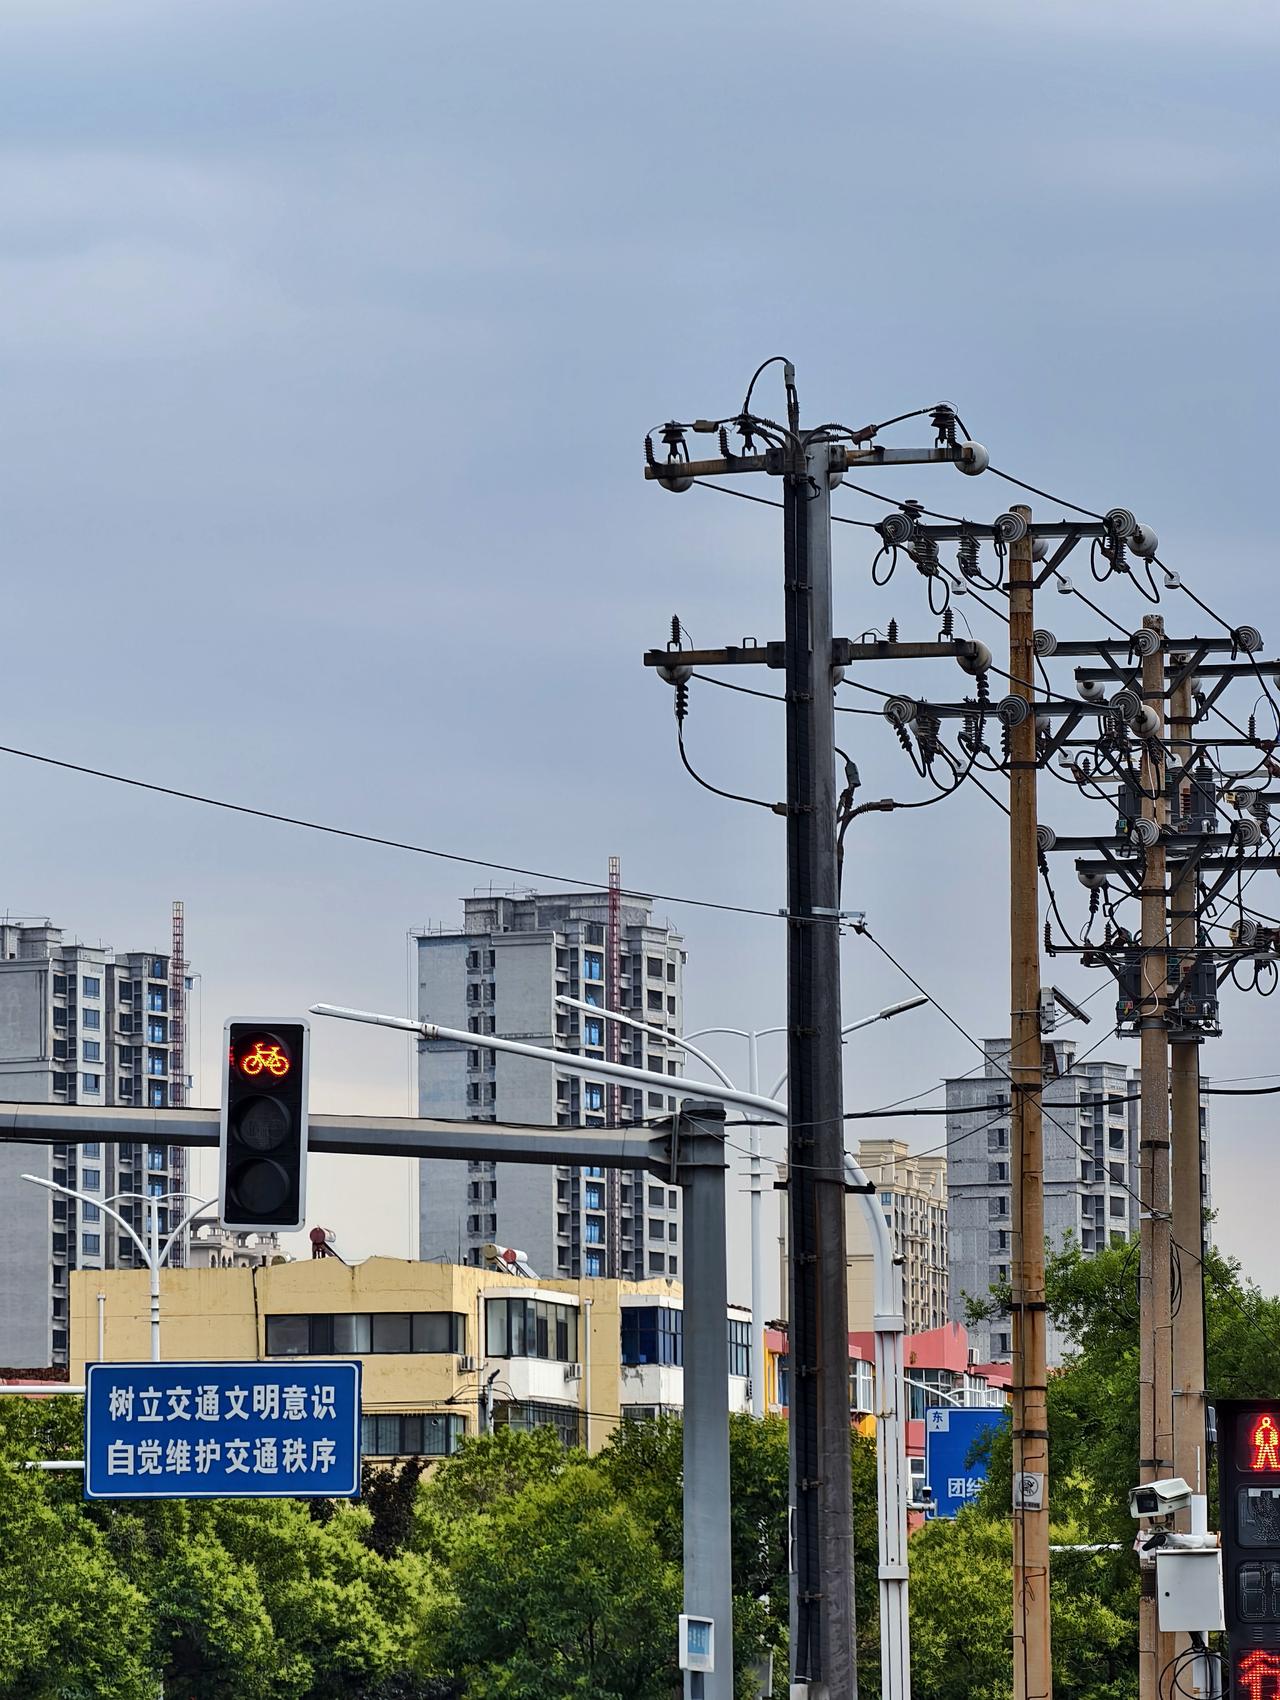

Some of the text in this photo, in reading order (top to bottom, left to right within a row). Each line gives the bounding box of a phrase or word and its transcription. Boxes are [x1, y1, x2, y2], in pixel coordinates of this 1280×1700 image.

[109, 1384, 336, 1421] 树立交通文明意识
[932, 1411, 943, 1423] 东
[107, 1437, 336, 1475] 自觉维护交通秩序
